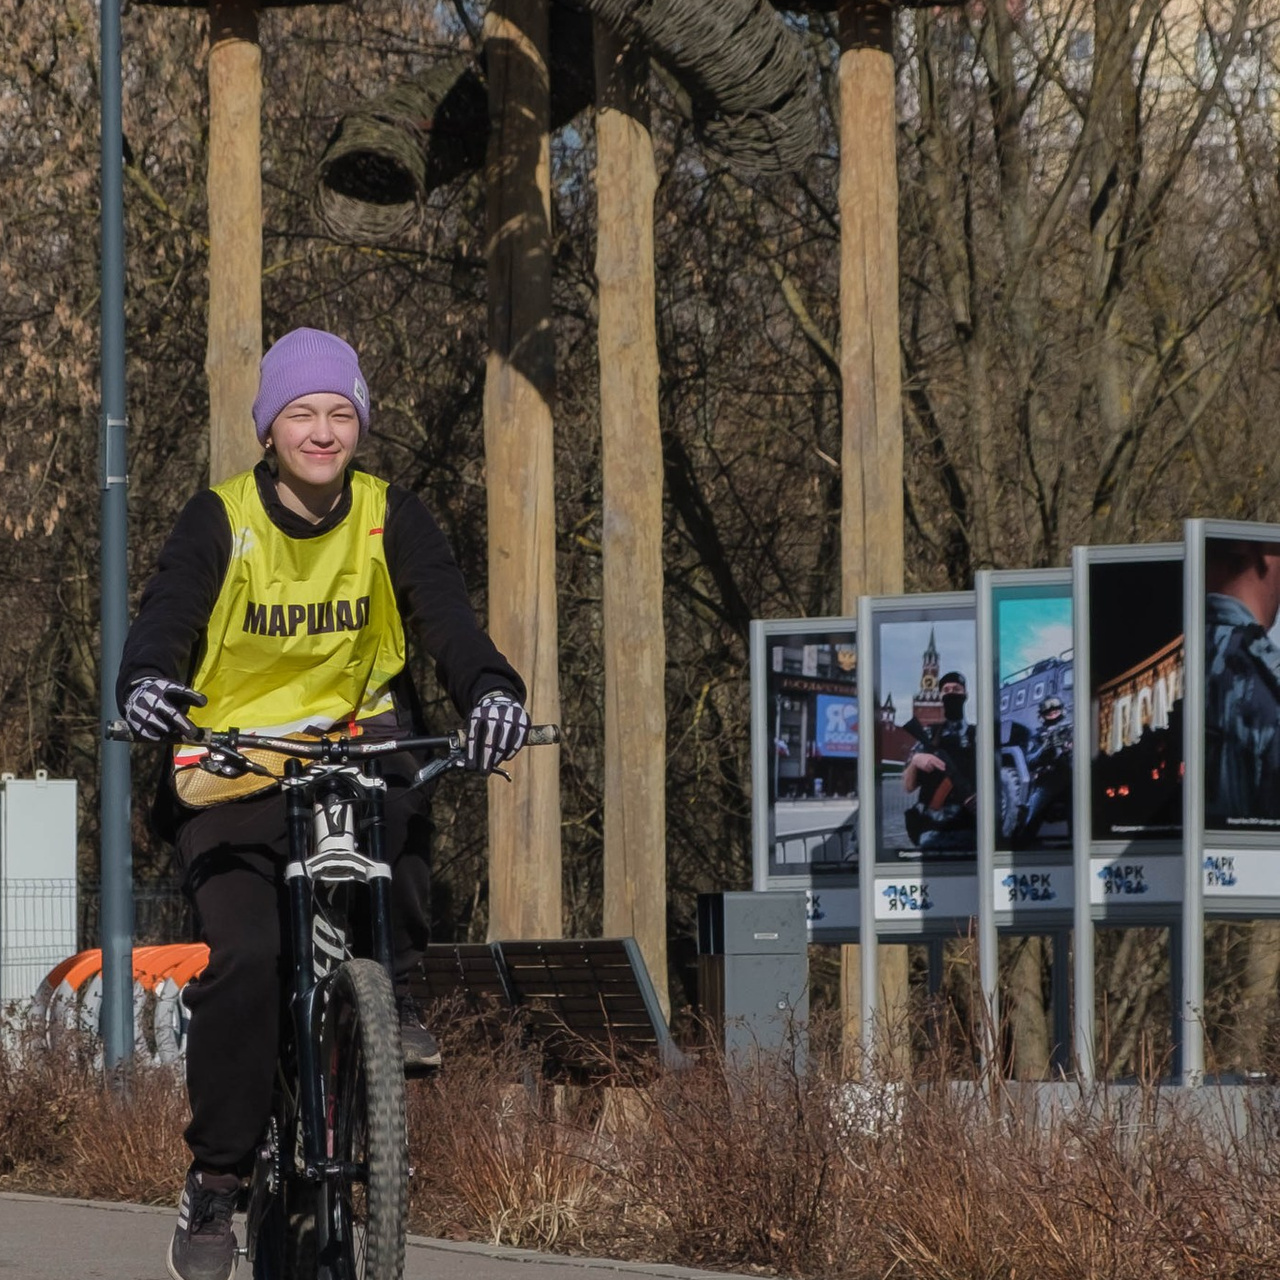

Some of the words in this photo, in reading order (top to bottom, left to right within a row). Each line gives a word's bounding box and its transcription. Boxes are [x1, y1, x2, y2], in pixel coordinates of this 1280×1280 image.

[242, 595, 370, 637] МАРШАЛ
[1008, 873, 1051, 887] ПАРК
[1103, 865, 1145, 880] ПАРК
[887, 884, 930, 898] ПАРК
[1008, 887, 1053, 902] ЯУЗА
[1104, 880, 1147, 895] ЯУЗА
[888, 897, 932, 911] ЯУЗА
